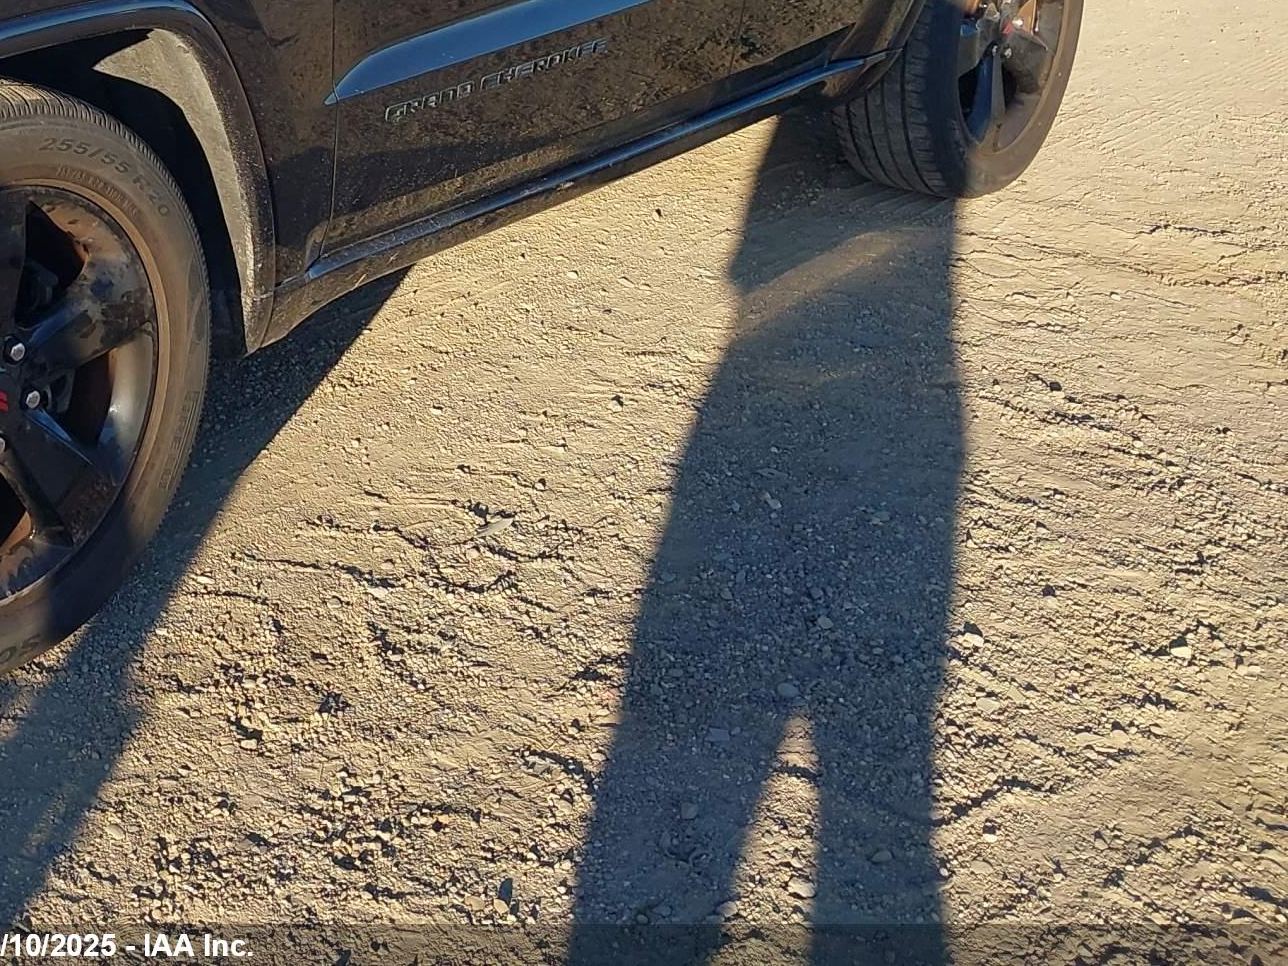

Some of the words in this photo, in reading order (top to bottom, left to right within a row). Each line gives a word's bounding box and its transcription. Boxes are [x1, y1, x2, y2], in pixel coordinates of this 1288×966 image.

[385, 81, 475, 123] GRAND
[480, 38, 609, 91] CHEROKEE
[38, 137, 130, 174] 255/55
